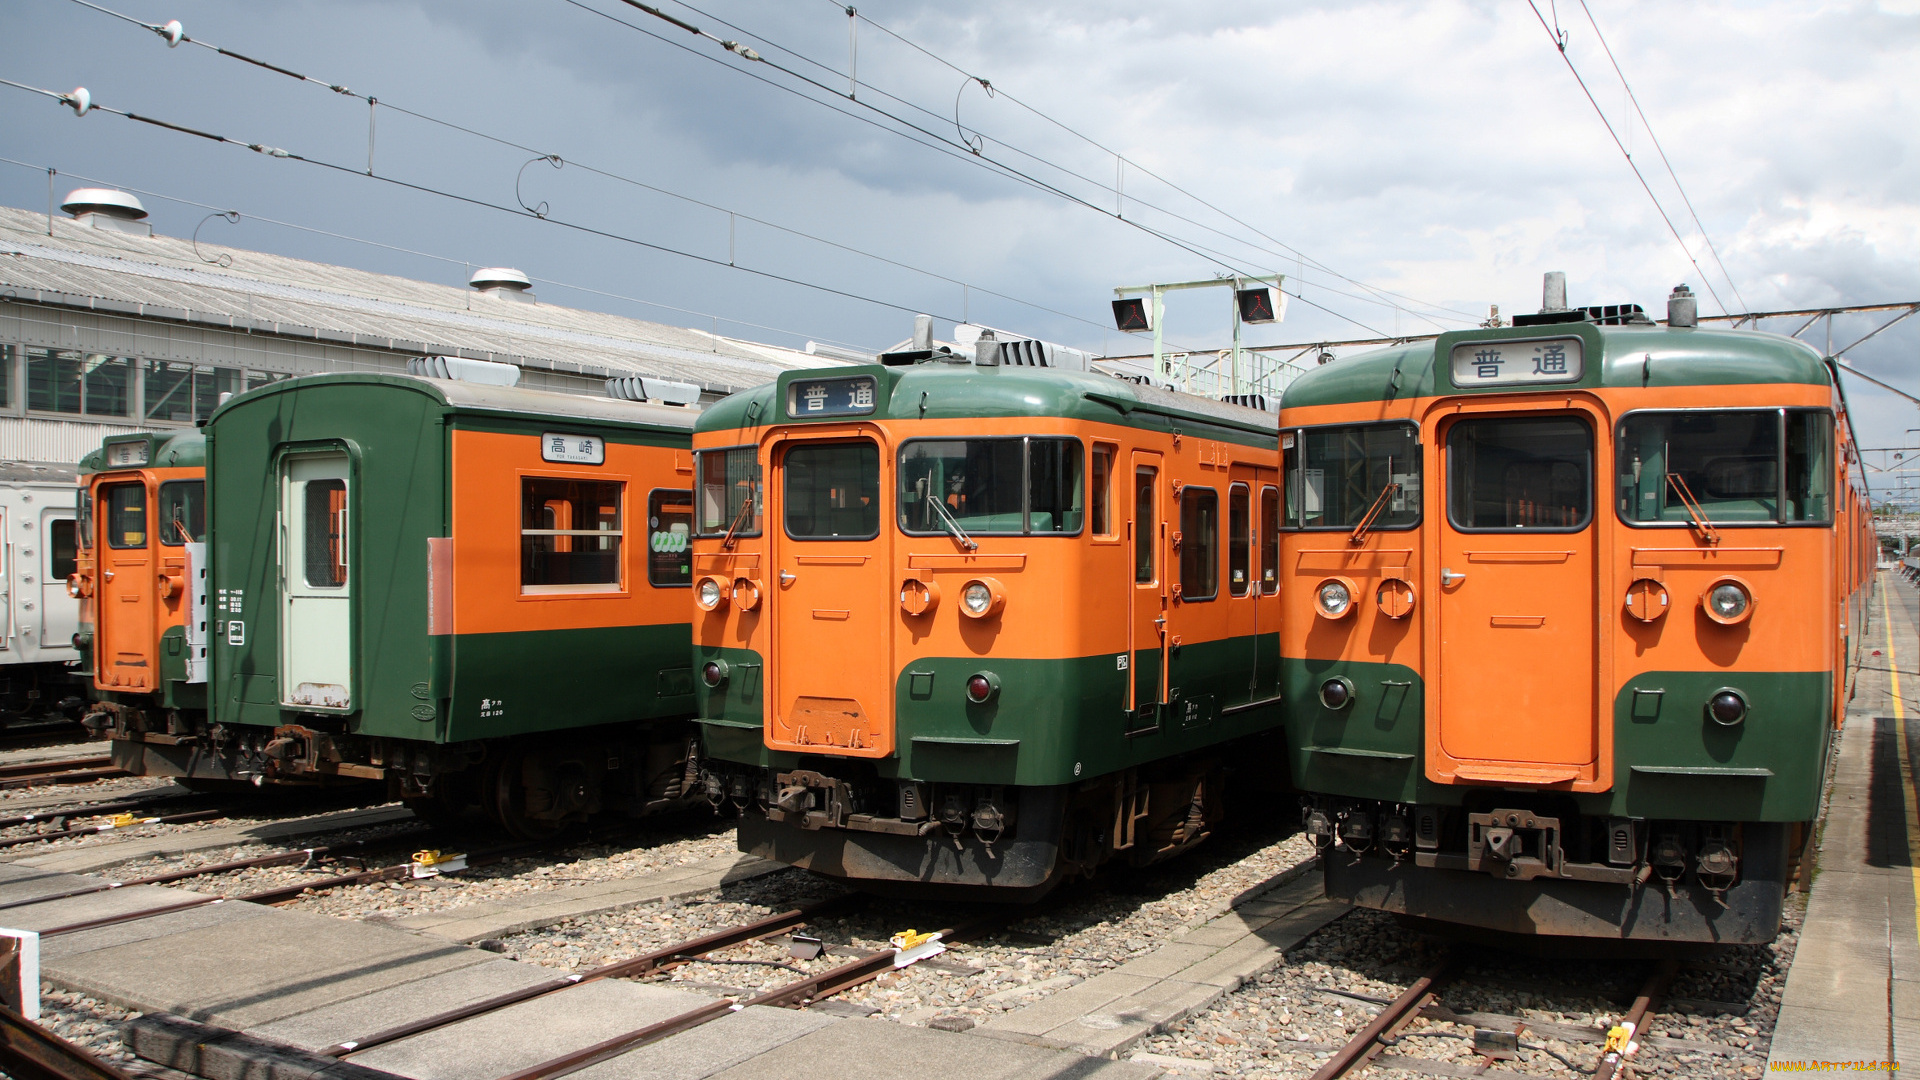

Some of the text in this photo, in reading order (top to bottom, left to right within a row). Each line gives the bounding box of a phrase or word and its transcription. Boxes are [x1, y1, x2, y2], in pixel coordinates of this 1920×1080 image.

[1471, 344, 1568, 378] 普通
[804, 382, 874, 411] 普通
[551, 437, 593, 455] 高崎
